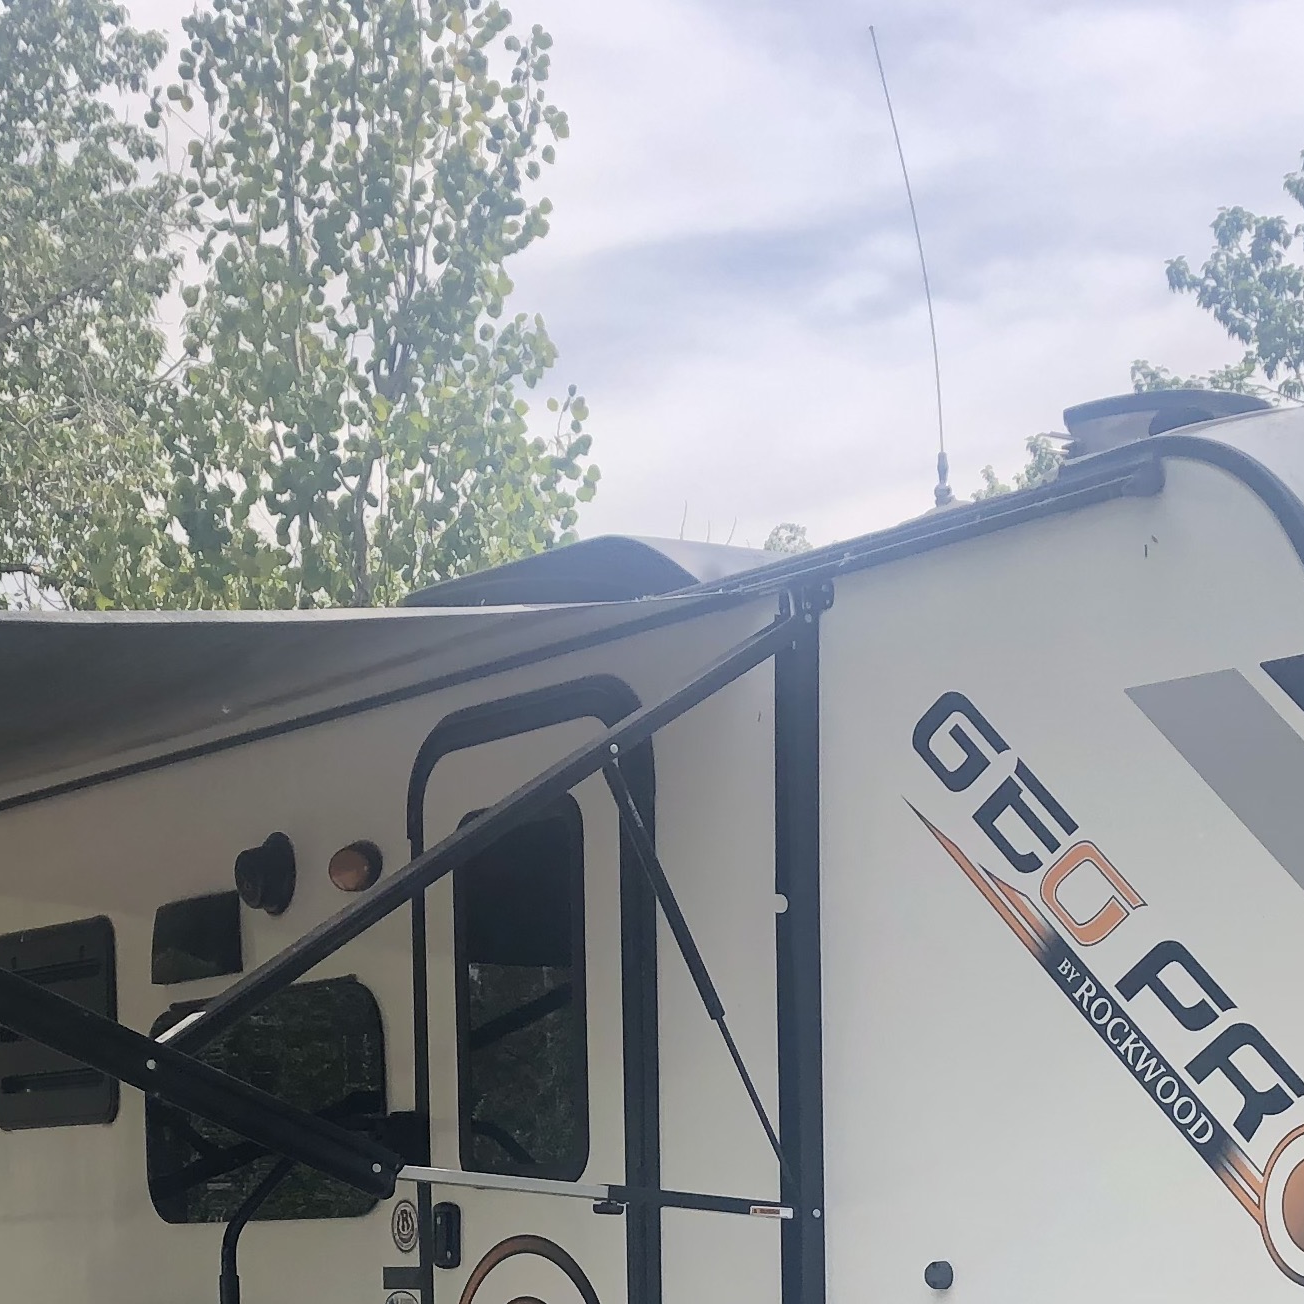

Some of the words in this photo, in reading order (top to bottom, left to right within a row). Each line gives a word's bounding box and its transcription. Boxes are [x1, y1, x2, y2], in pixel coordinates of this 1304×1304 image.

[912, 691, 1148, 947] GEO
[1057, 958, 1081, 984] BY
[1072, 976, 1215, 1147] ROCKWOOD
